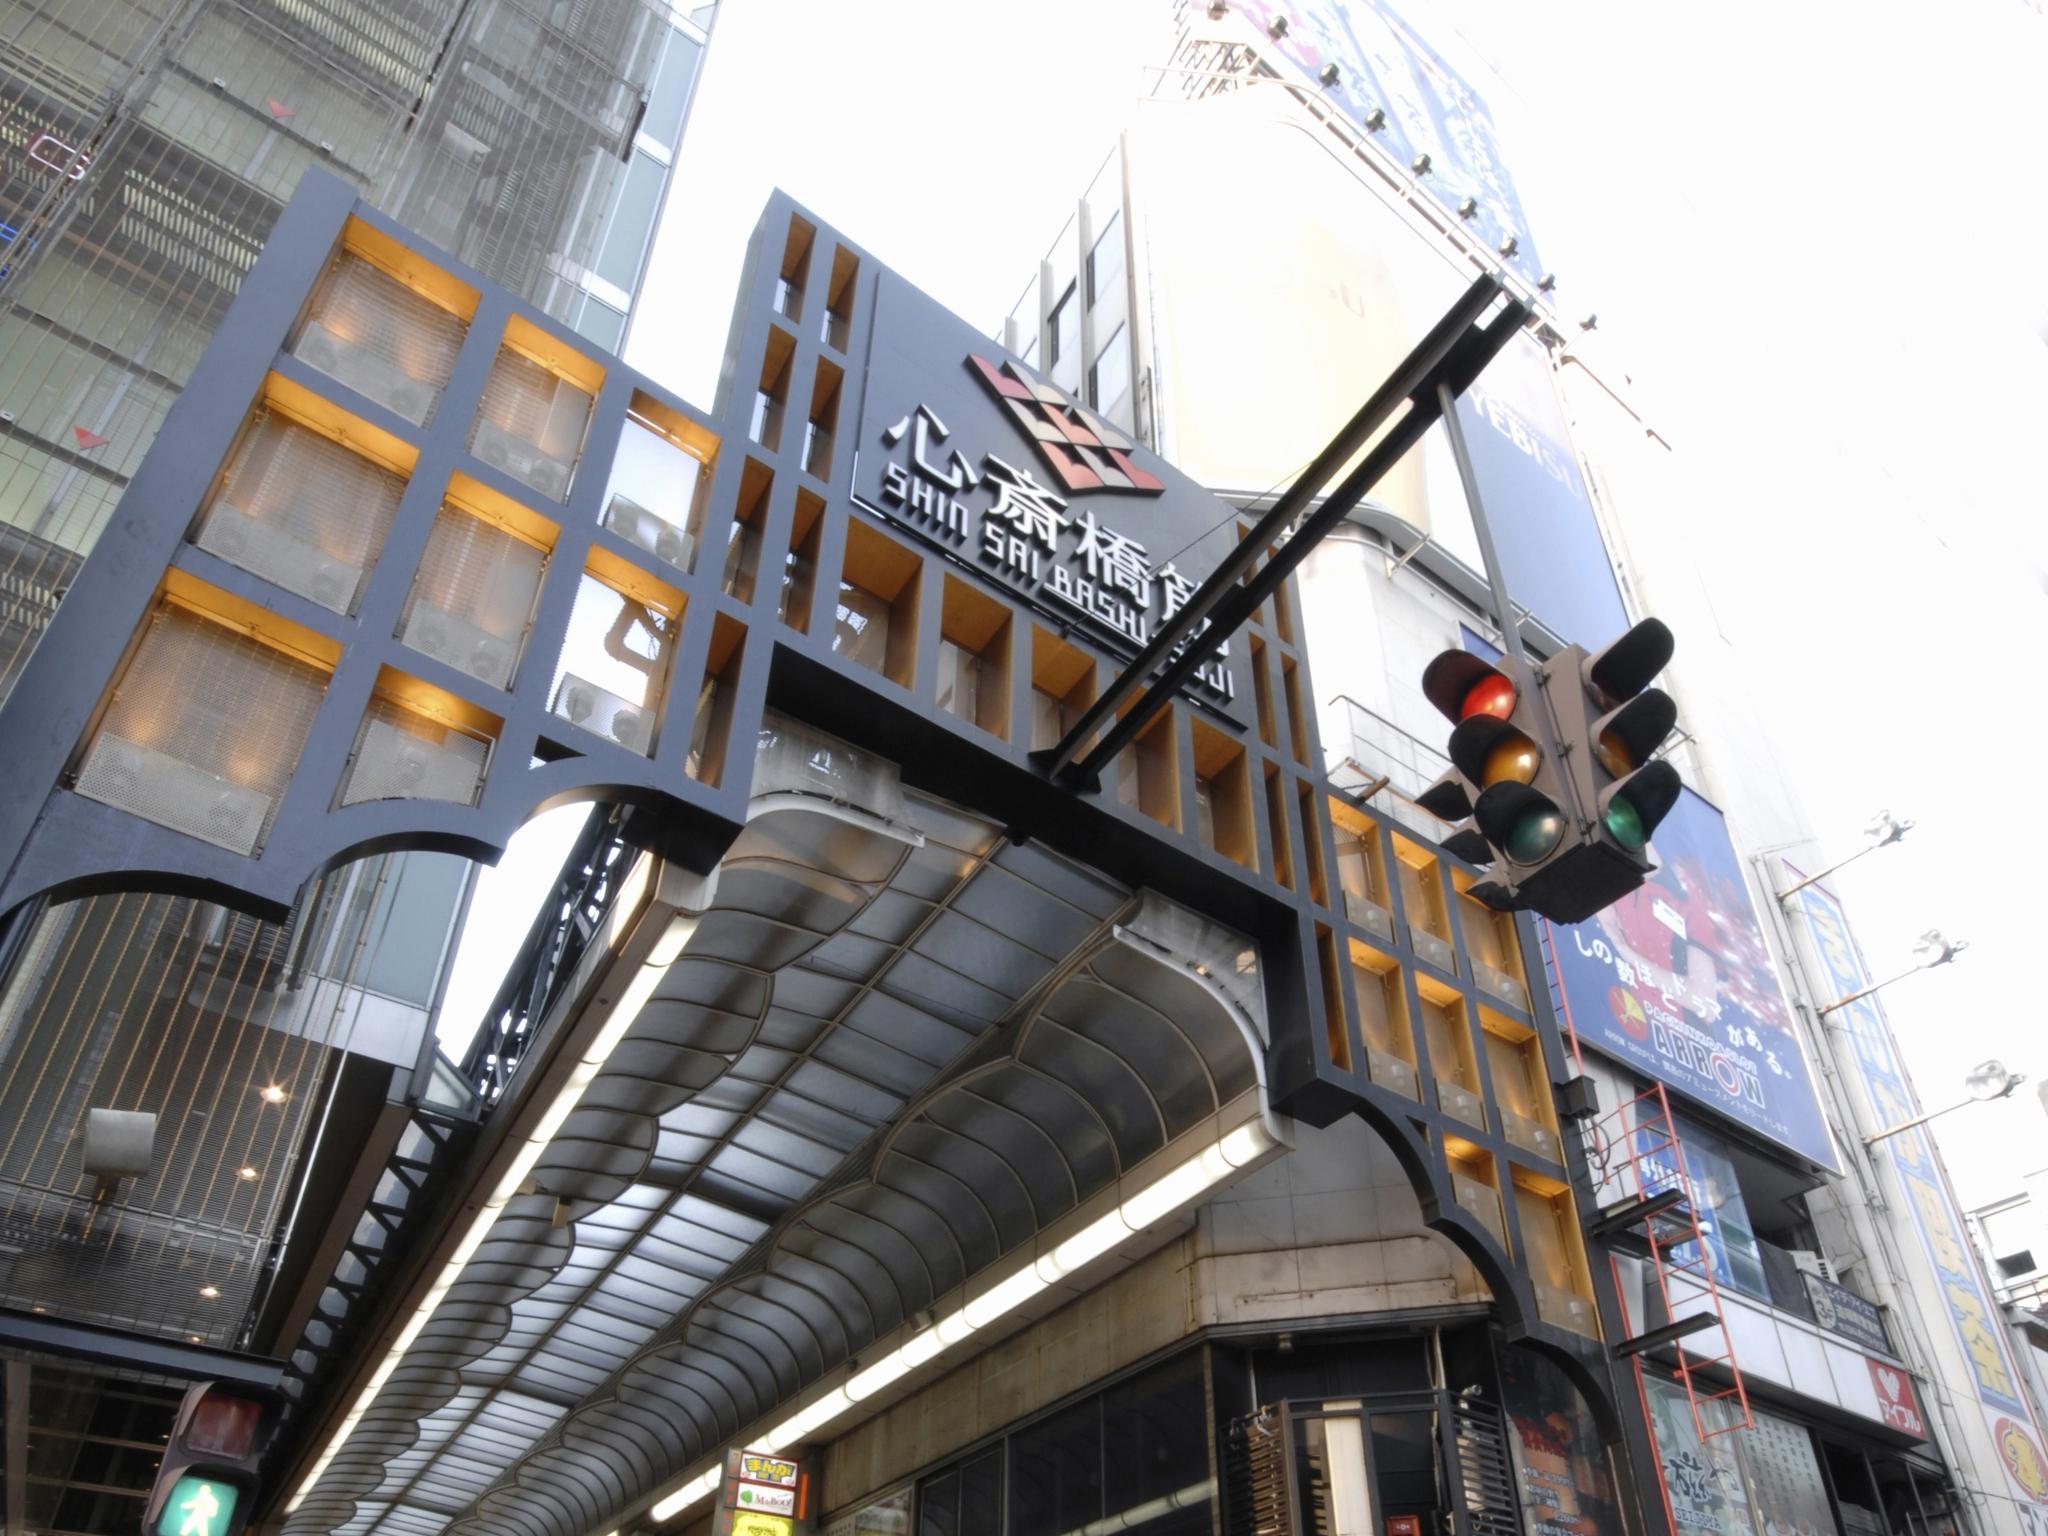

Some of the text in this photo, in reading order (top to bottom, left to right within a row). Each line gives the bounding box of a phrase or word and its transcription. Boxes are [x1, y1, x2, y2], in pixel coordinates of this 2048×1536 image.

[884, 462, 968, 540] SHIN
[984, 522, 1039, 581] SAI
[1651, 1019, 1766, 1109] ARROW
[1879, 1397, 1921, 1433] アイフル
